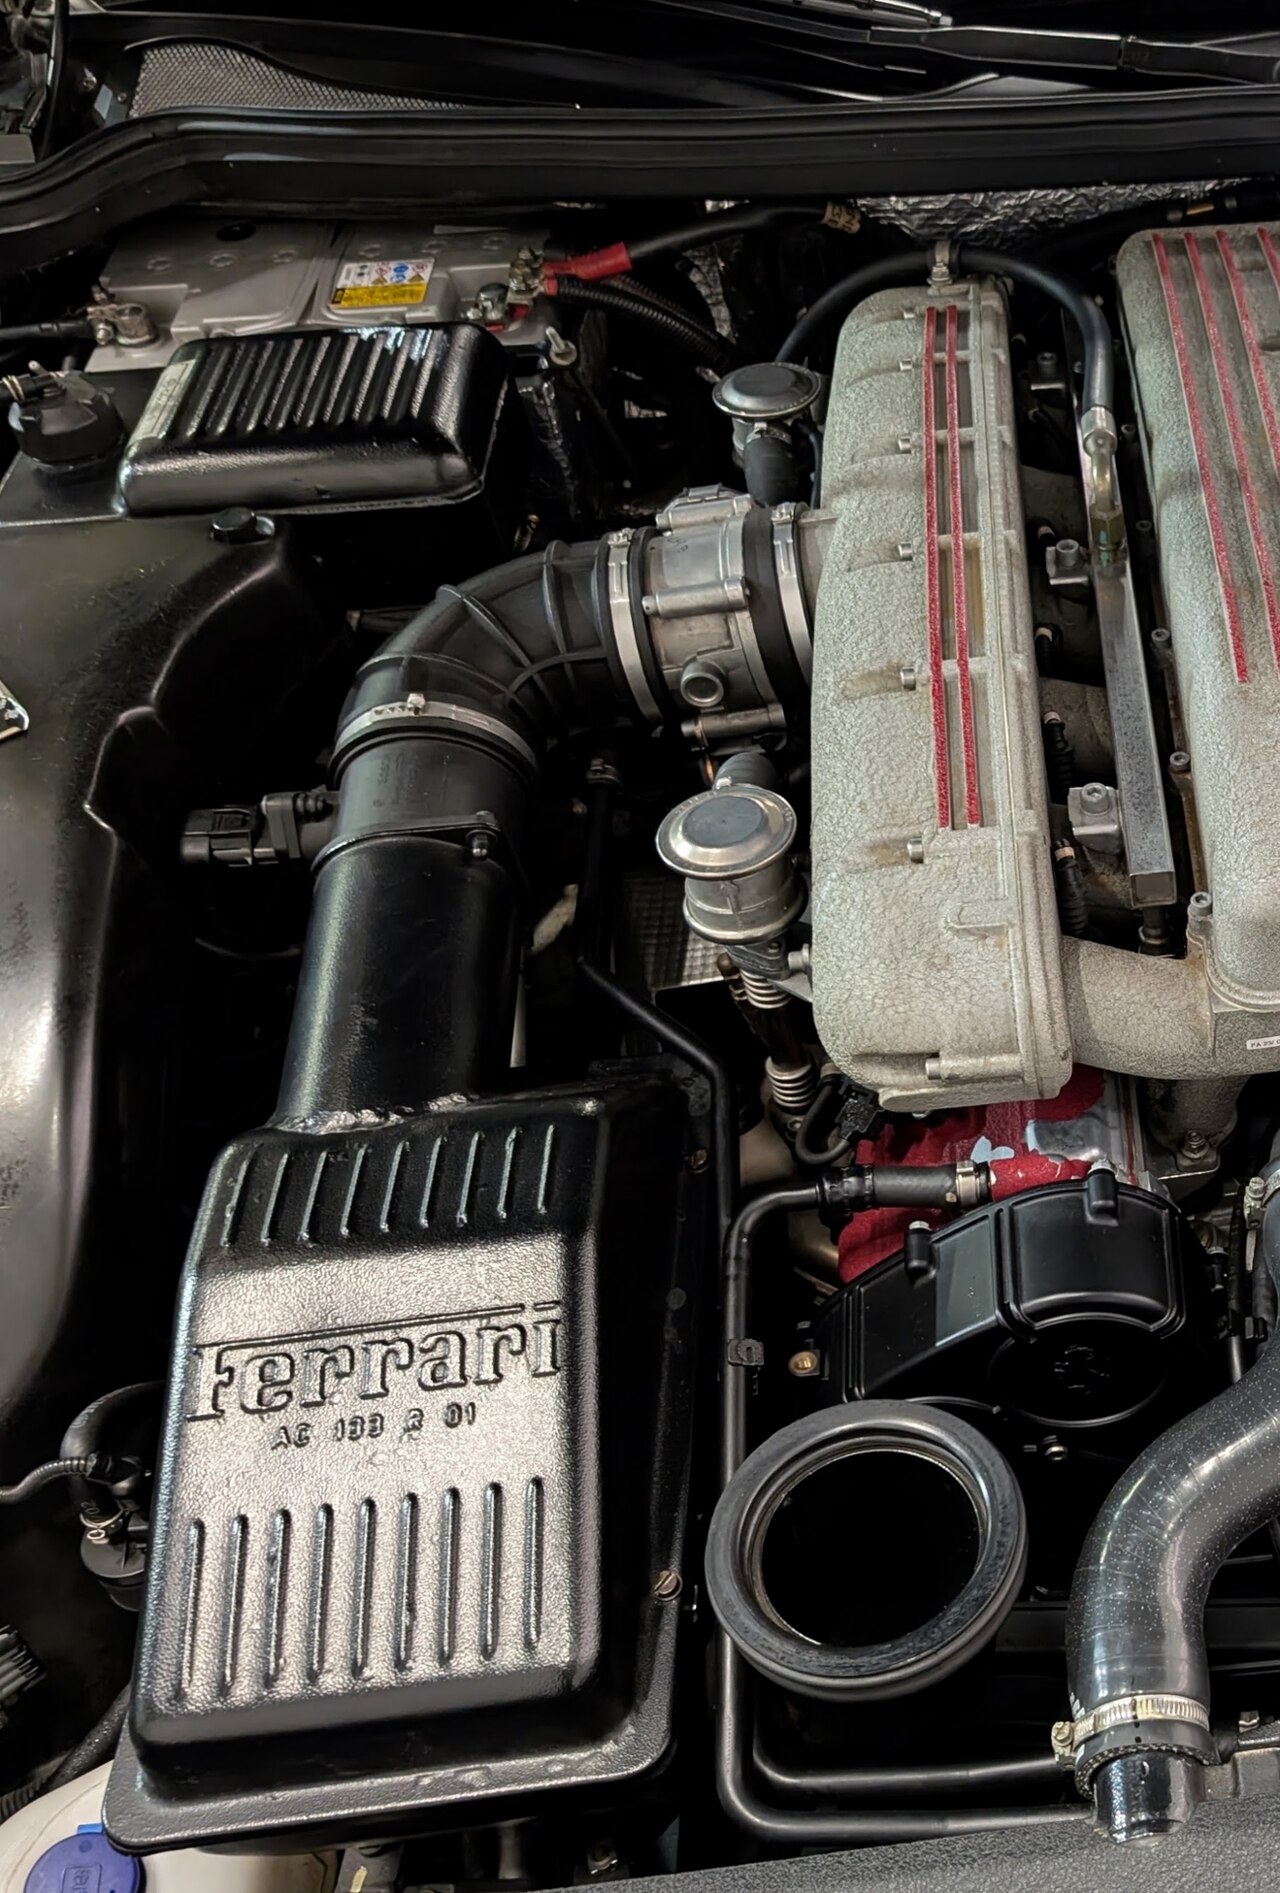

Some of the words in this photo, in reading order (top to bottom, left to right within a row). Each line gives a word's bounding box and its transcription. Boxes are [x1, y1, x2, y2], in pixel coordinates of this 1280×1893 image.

[183, 1299, 562, 1422] Ferrari
[271, 1424, 313, 1450] AC
[334, 1412, 385, 1441] 133
[444, 1401, 477, 1430] 01
